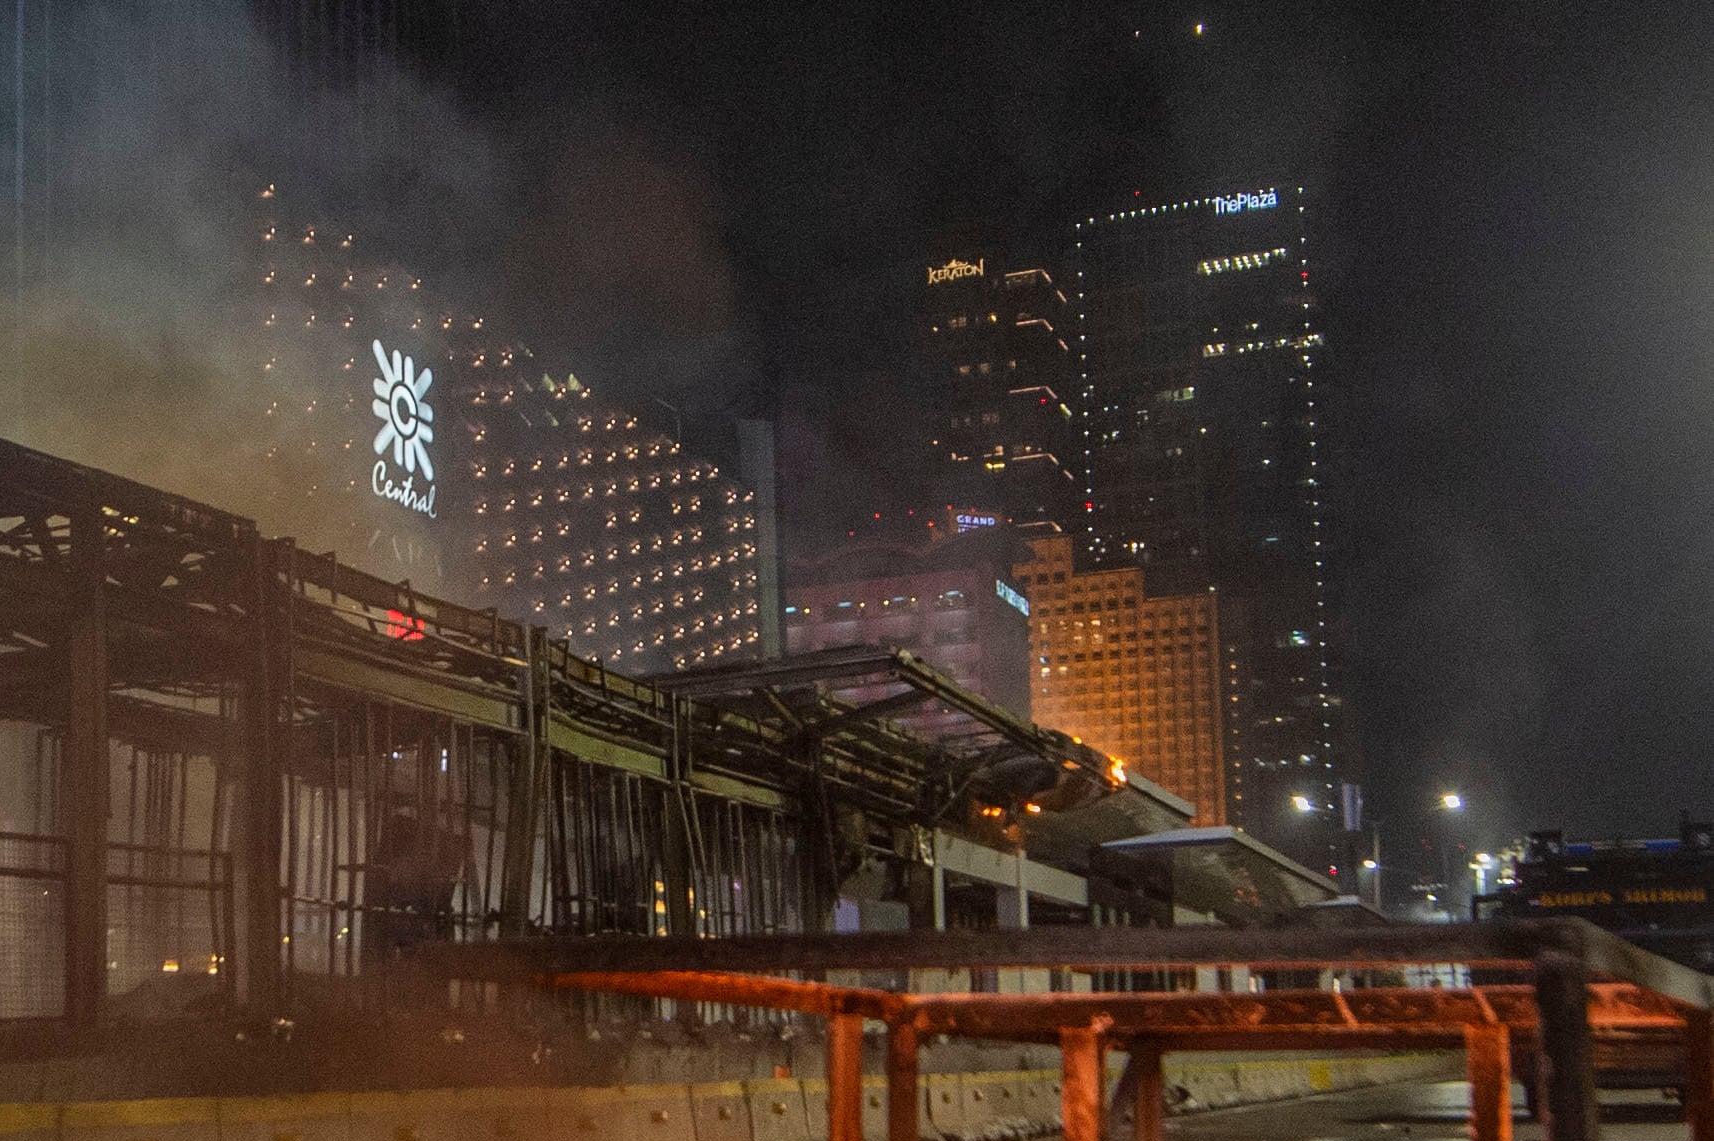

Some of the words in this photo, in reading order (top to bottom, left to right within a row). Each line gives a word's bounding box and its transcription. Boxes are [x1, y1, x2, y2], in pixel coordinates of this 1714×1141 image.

[927, 257, 984, 285] KERATON
[372, 460, 437, 519] Central
[956, 514, 995, 526] GRAND
